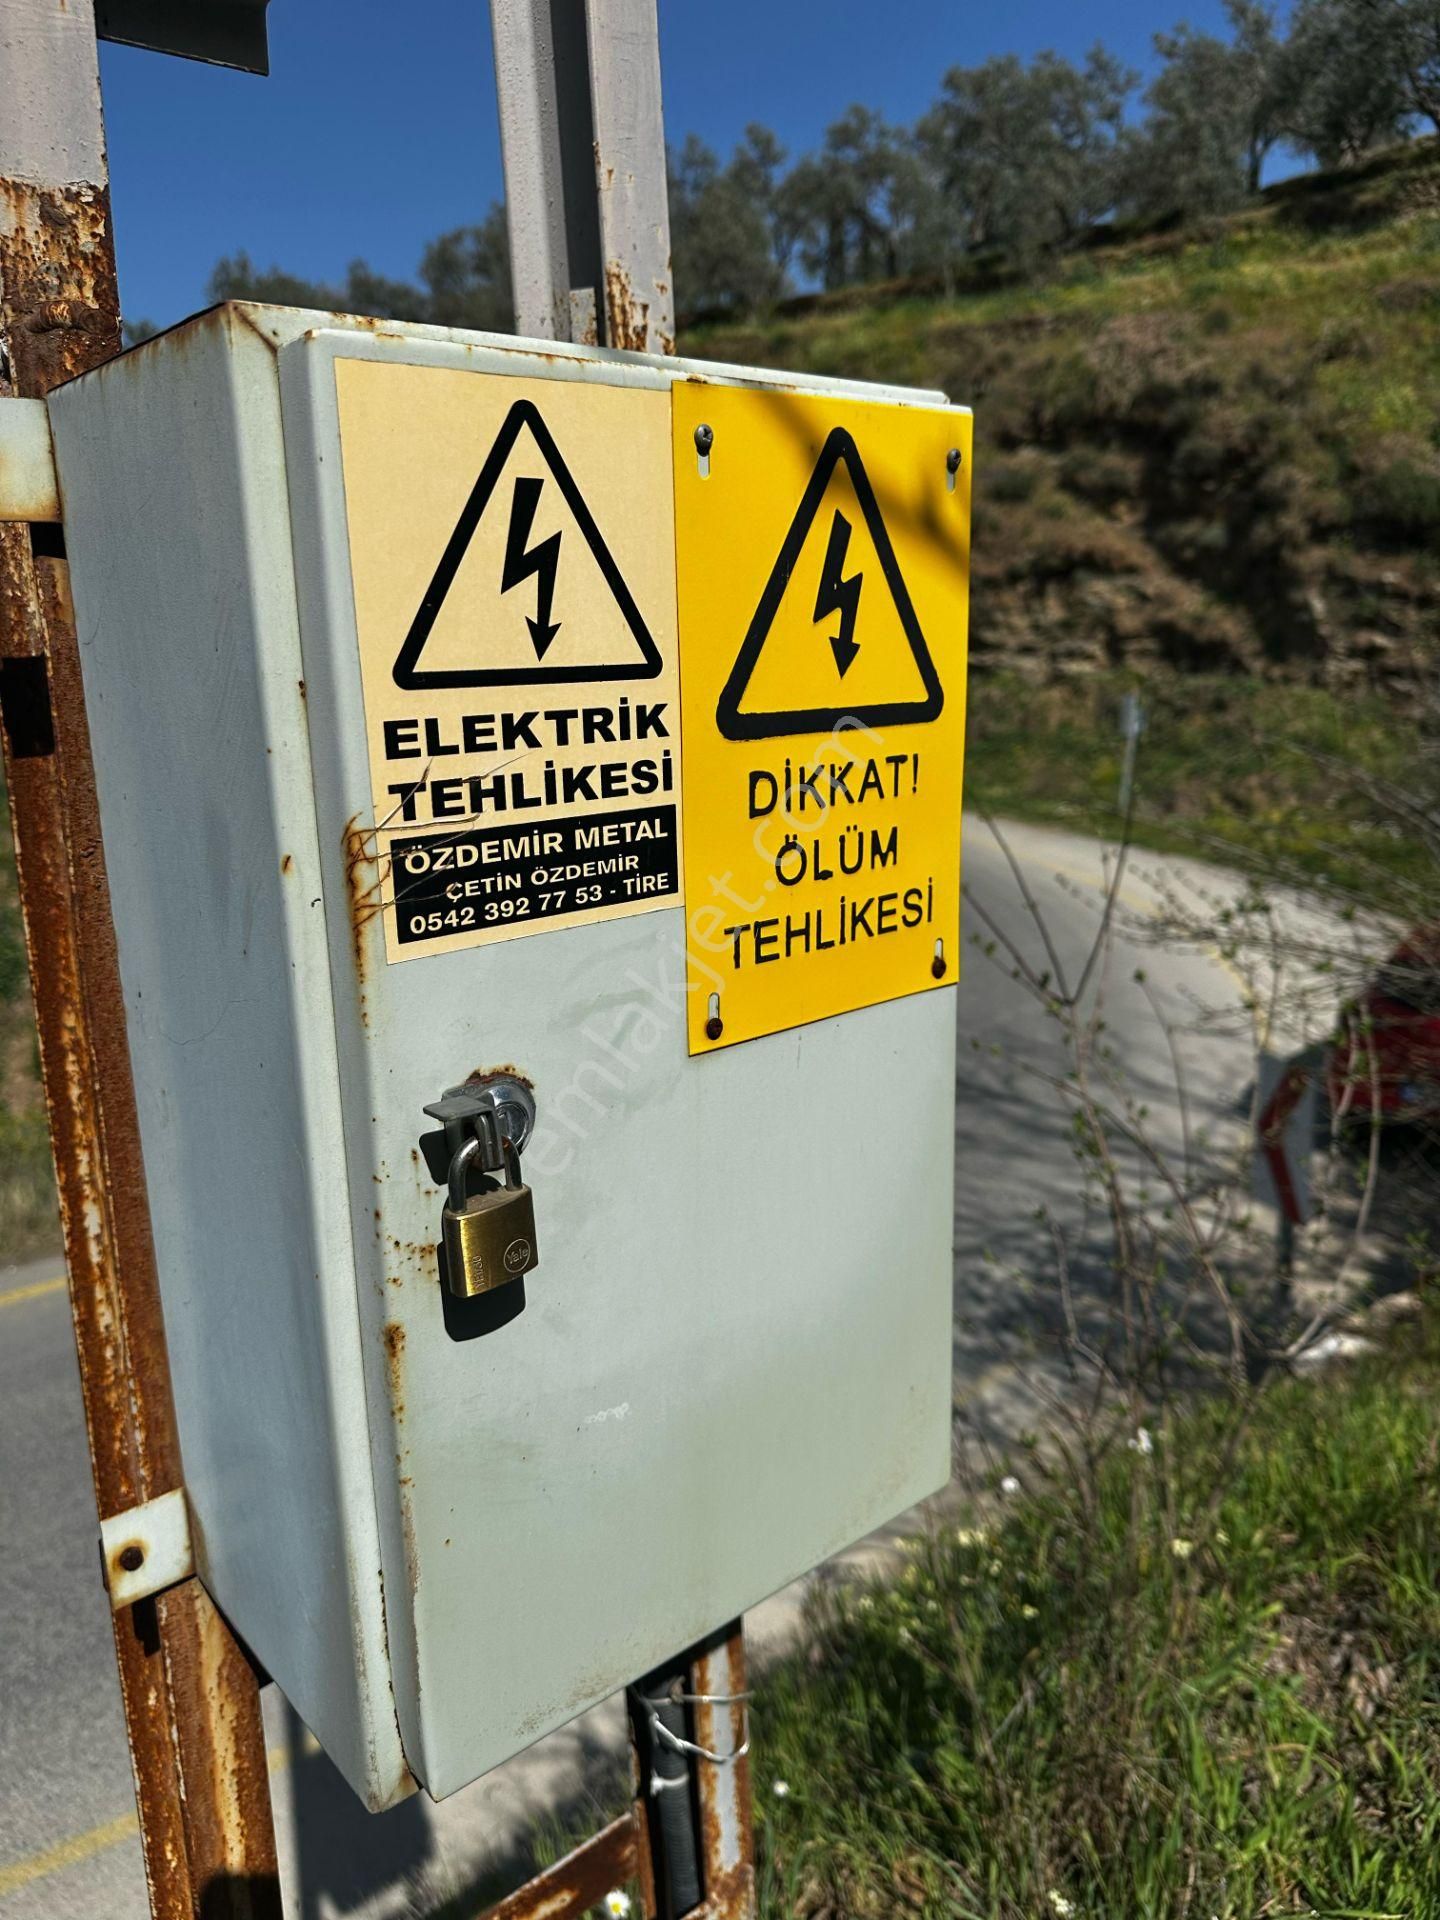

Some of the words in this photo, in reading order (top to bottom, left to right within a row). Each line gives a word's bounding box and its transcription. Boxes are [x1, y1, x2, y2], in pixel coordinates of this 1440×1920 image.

[383, 697, 670, 760] ELEKTRİK
[388, 749, 673, 822] TEHLİKESİ
[749, 753, 919, 819] DİKKAT!
[405, 829, 563, 874] ÖZDEMİR
[575, 818, 668, 850] METAL
[775, 824, 898, 887] ÖLÜM
[410, 906, 476, 935] 0542
[484, 897, 531, 920] 392
[538, 890, 567, 911] 77
[575, 884, 603, 903] 53
[623, 872, 670, 897] TİRE
[446, 874, 522, 903] ÇETİN
[530, 854, 639, 886] ÖZDEMİR
[724, 876, 933, 969] TEHLİKESİ
[506, 1248, 529, 1265] Yale
